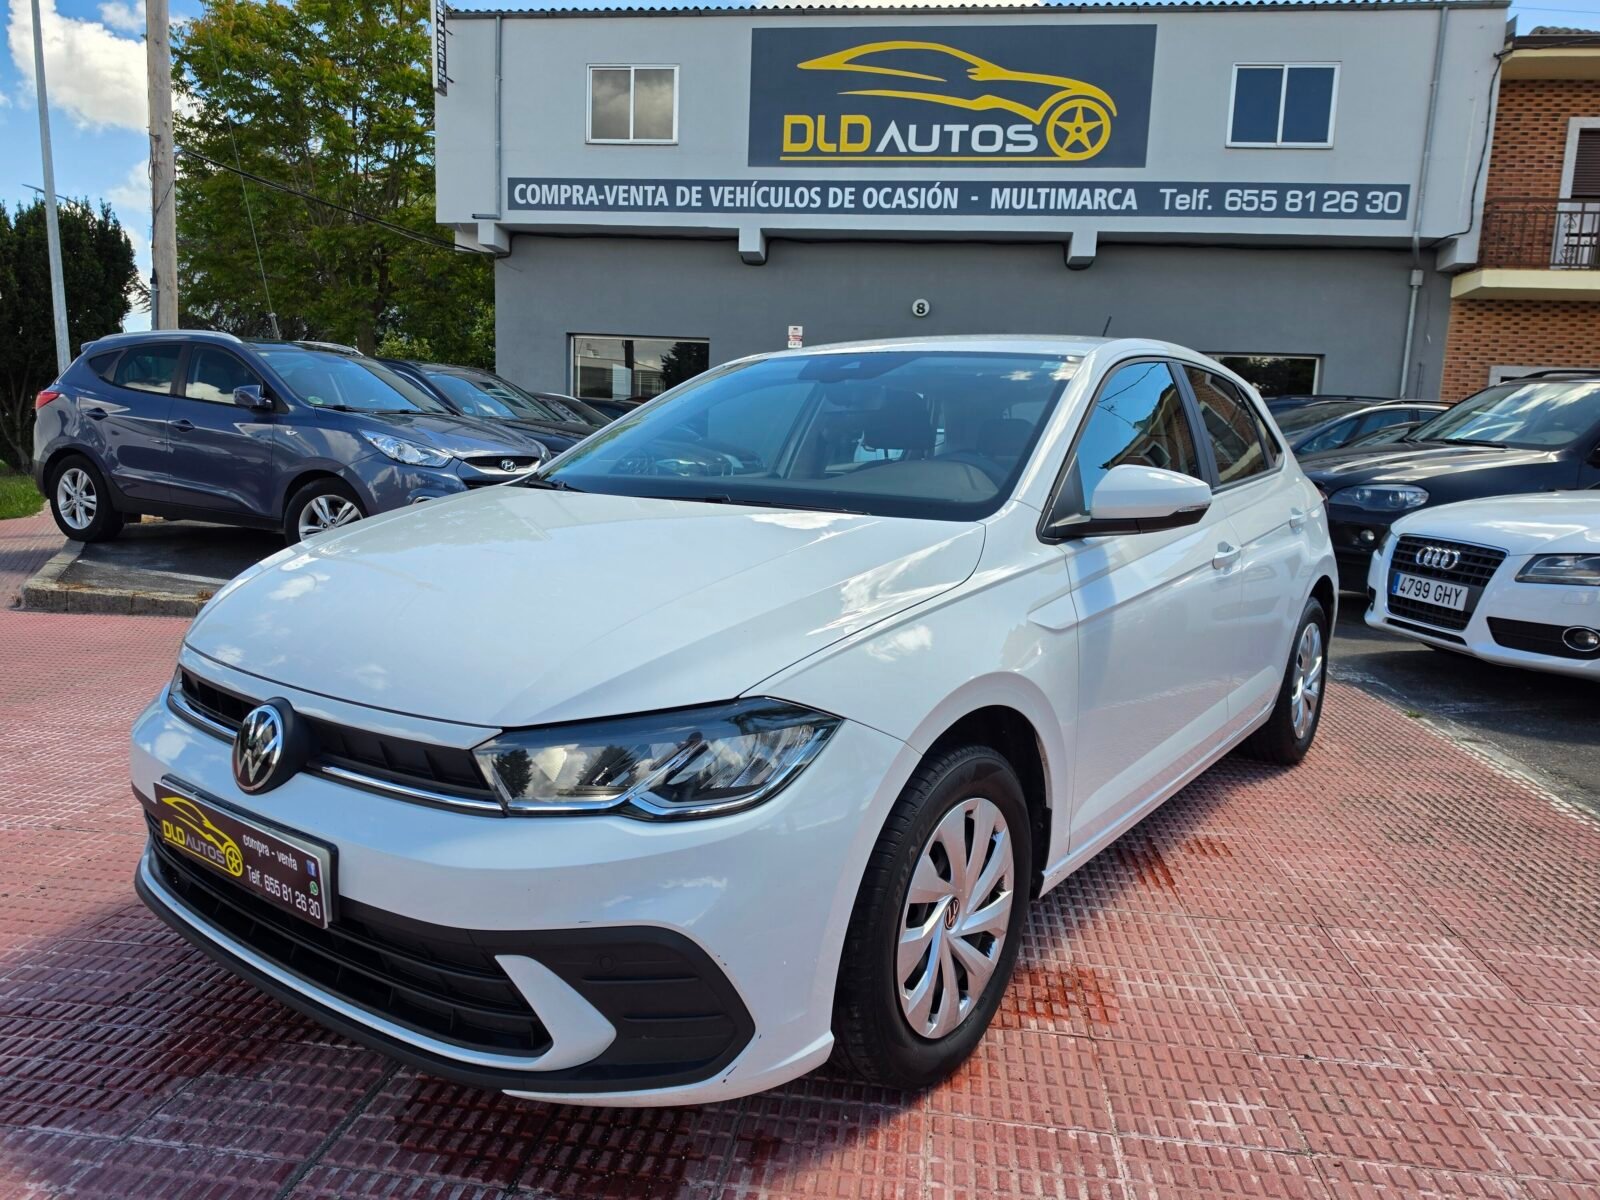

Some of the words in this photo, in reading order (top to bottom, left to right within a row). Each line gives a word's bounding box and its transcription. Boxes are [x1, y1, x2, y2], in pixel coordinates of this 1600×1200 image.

[783, 114, 872, 153] DLD
[875, 120, 1039, 153] AUTOS
[513, 183, 669, 207] COMPRA-VENTA
[676, 186, 702, 207] DE
[709, 181, 822, 209] VEHÍCULOS
[828, 187, 855, 209] DE
[862, 182, 959, 209] OCASIÓN
[990, 187, 1138, 211] MULTIMARCA
[1160, 188, 1212, 211] Telf.
[1224, 189, 1278, 212] 655
[1365, 191, 1402, 214] 30
[916, 302, 926, 315] 8
[1399, 577, 1431, 599] 4799
[1433, 584, 1463, 607] GHY
[162, 819, 186, 845] DLD
[185, 833, 226, 865] AUTOS
[243, 834, 270, 858] compra
[277, 851, 298, 871] venta
[246, 865, 263, 888] Telf.
[264, 875, 281, 898] 655
[281, 884, 293, 905] 81
[295, 891, 308, 912] 26
[308, 898, 321, 920] 30
